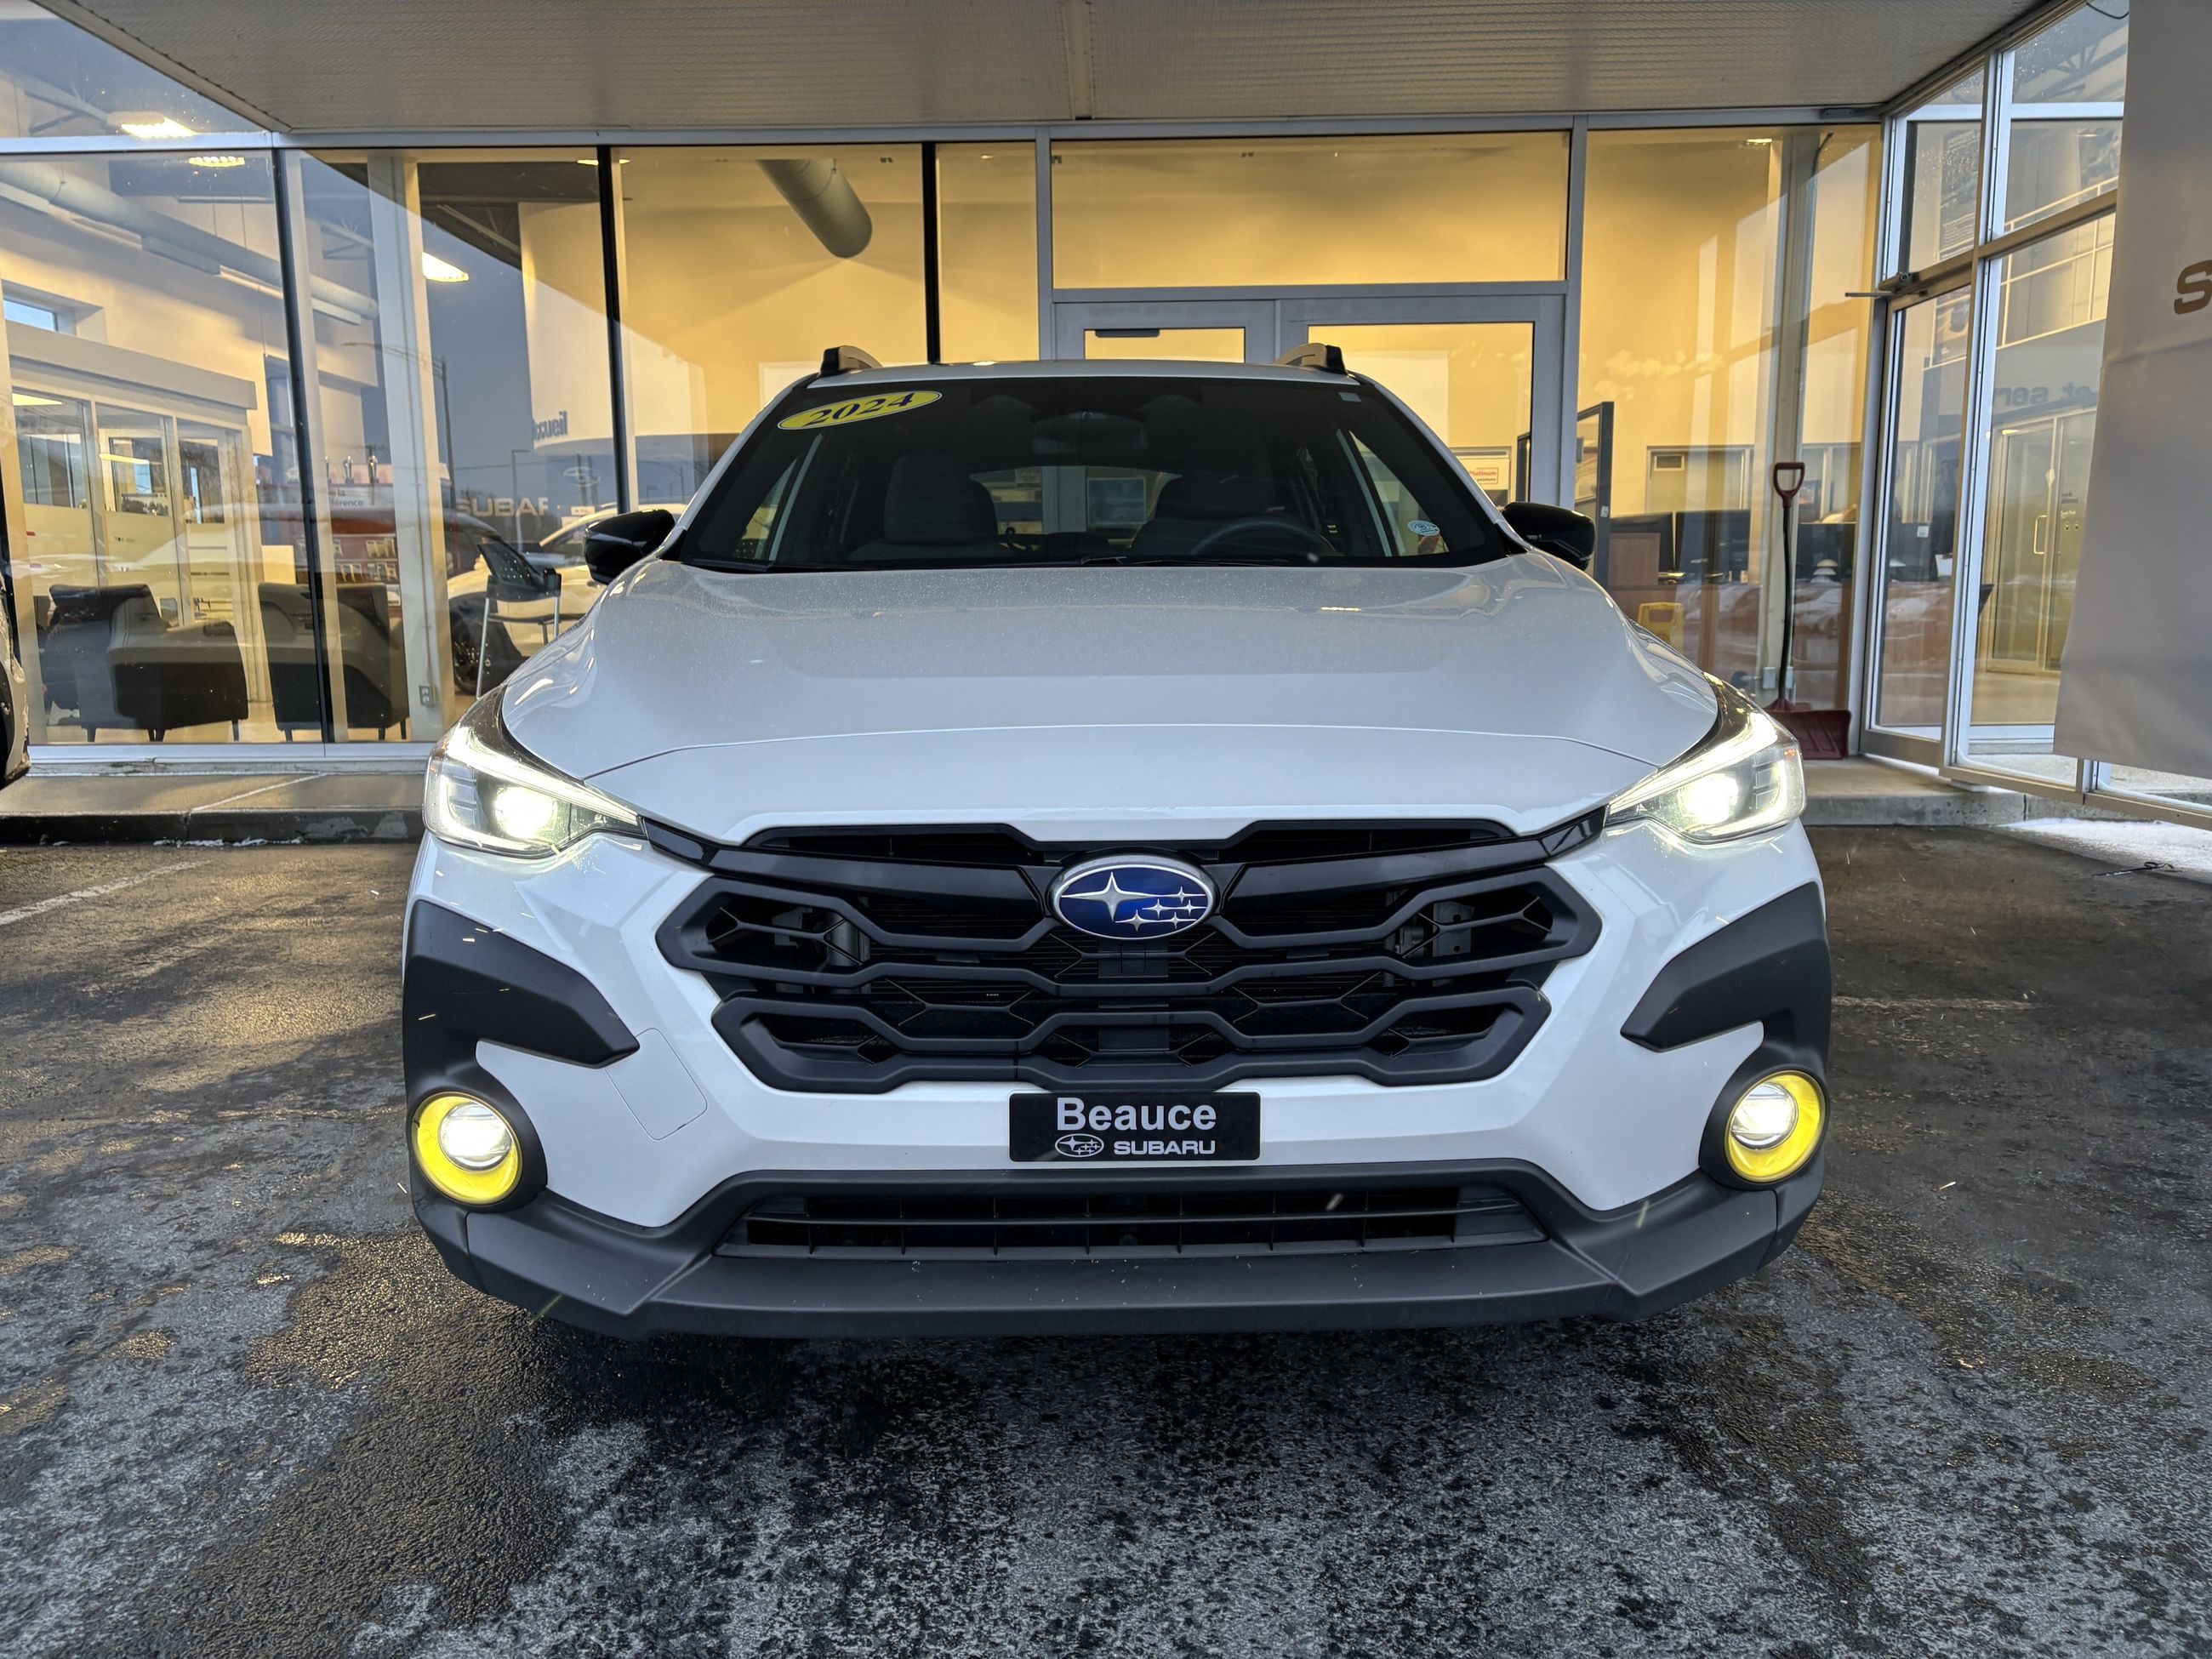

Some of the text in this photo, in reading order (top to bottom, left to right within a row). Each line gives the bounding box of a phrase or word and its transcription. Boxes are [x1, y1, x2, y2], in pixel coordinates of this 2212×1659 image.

[802, 392, 915, 427] 2024
[1058, 1097, 1217, 1131] Beauce
[1114, 1140, 1216, 1155] SUBARU
